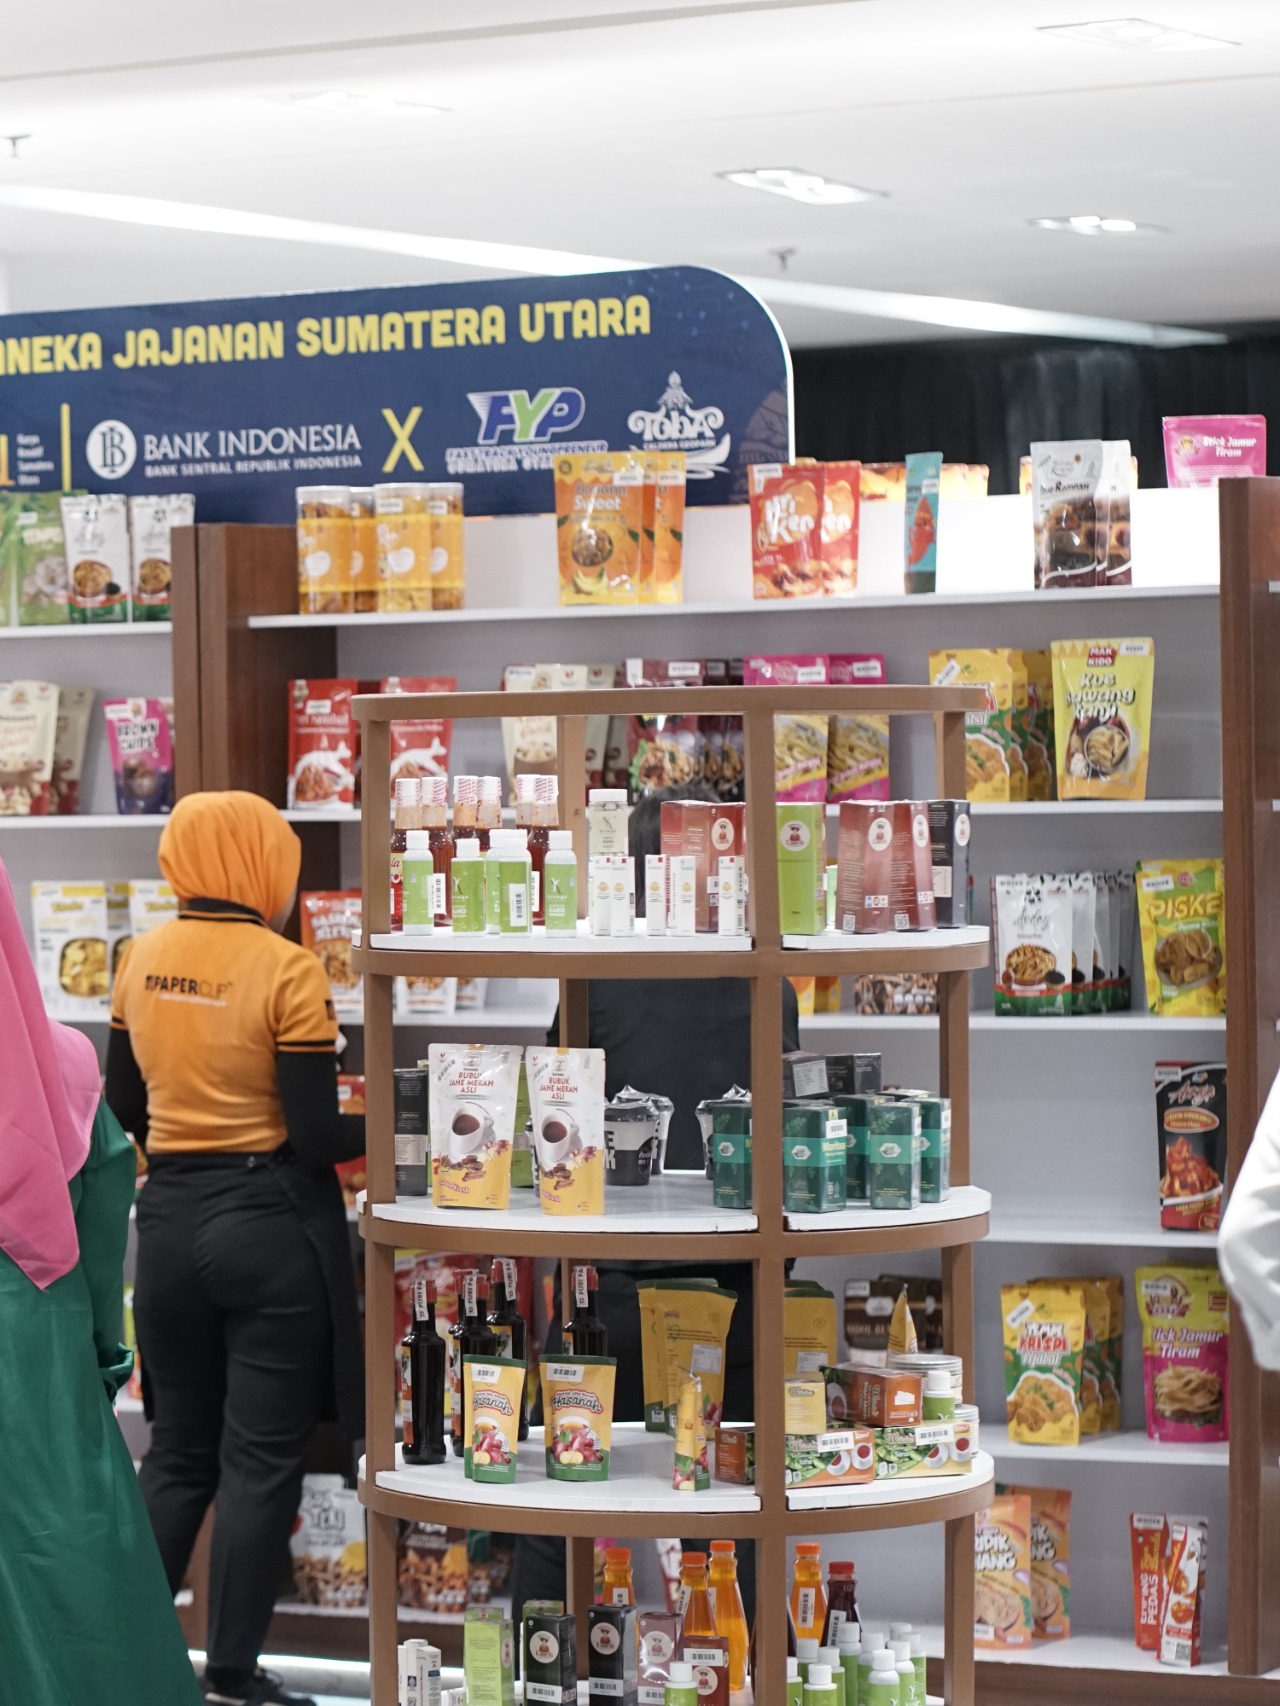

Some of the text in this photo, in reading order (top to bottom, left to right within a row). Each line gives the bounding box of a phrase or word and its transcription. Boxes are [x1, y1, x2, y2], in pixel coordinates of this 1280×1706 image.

[112, 320, 284, 370] JAJANAN
[296, 304, 506, 358] SUMATERA
[519, 294, 651, 343] UTARA
[467, 387, 586, 444] FYP
[144, 424, 361, 461] BANK INDONESIA
[1202, 436, 1256, 448] Stick Jamur
[1216, 447, 1242, 457] Tiram
[145, 455, 361, 478] BANK SENTRAL REPUBLIK INDONESIA
[575, 495, 621, 511] Sweet
[1080, 673, 1115, 688] Kue
[548, 1077, 570, 1085] BUBUK
[556, 1085, 578, 1093] MERAH
[1020, 1334, 1067, 1351] KRISPI
[1179, 1329, 1224, 1343] Jamur
[1160, 1344, 1200, 1359] Tiram
[552, 1396, 601, 1413] Hasanah
[1148, 1574, 1158, 1625] PEDAS
